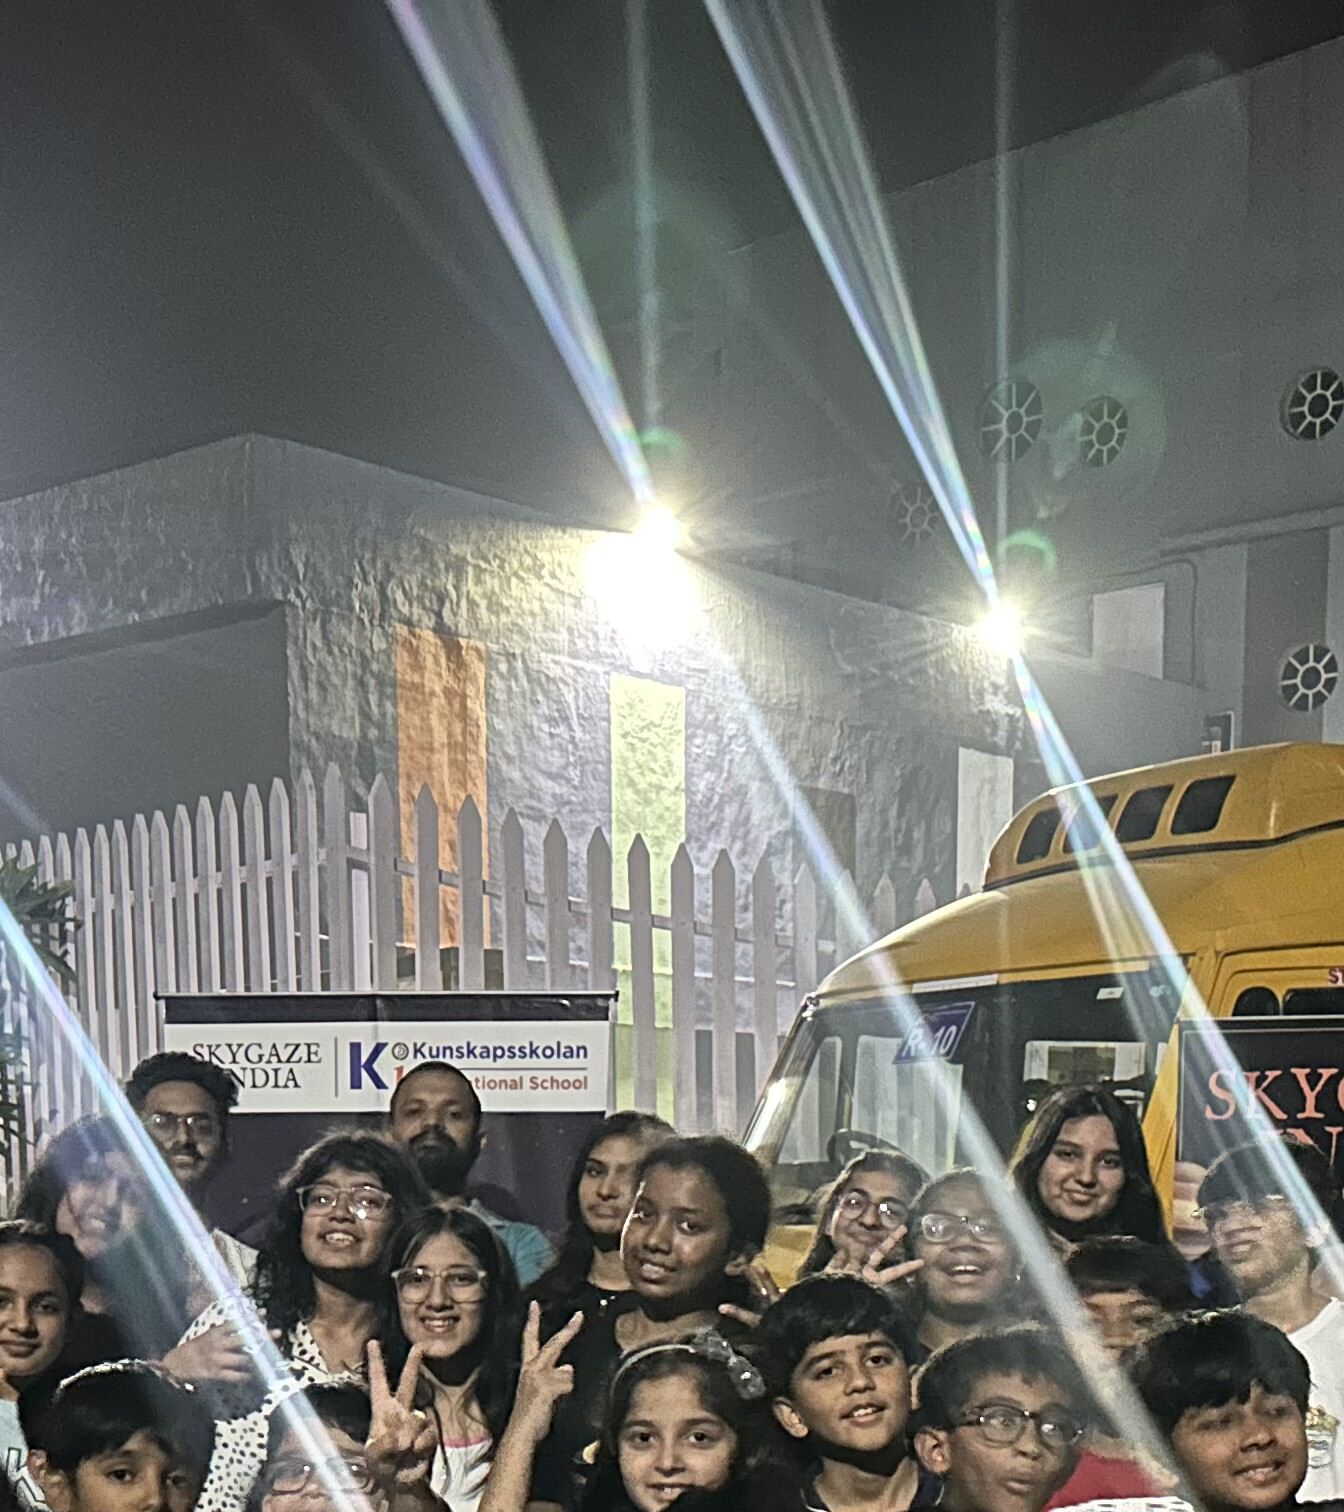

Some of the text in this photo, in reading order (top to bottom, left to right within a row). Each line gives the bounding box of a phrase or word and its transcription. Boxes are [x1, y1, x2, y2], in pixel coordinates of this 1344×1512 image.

[192, 1042, 322, 1065] SKYGAZE
[413, 1041, 588, 1062] Kunskapsskolan
[225, 1067, 302, 1089] NDIA
[529, 1076, 588, 1091] School
